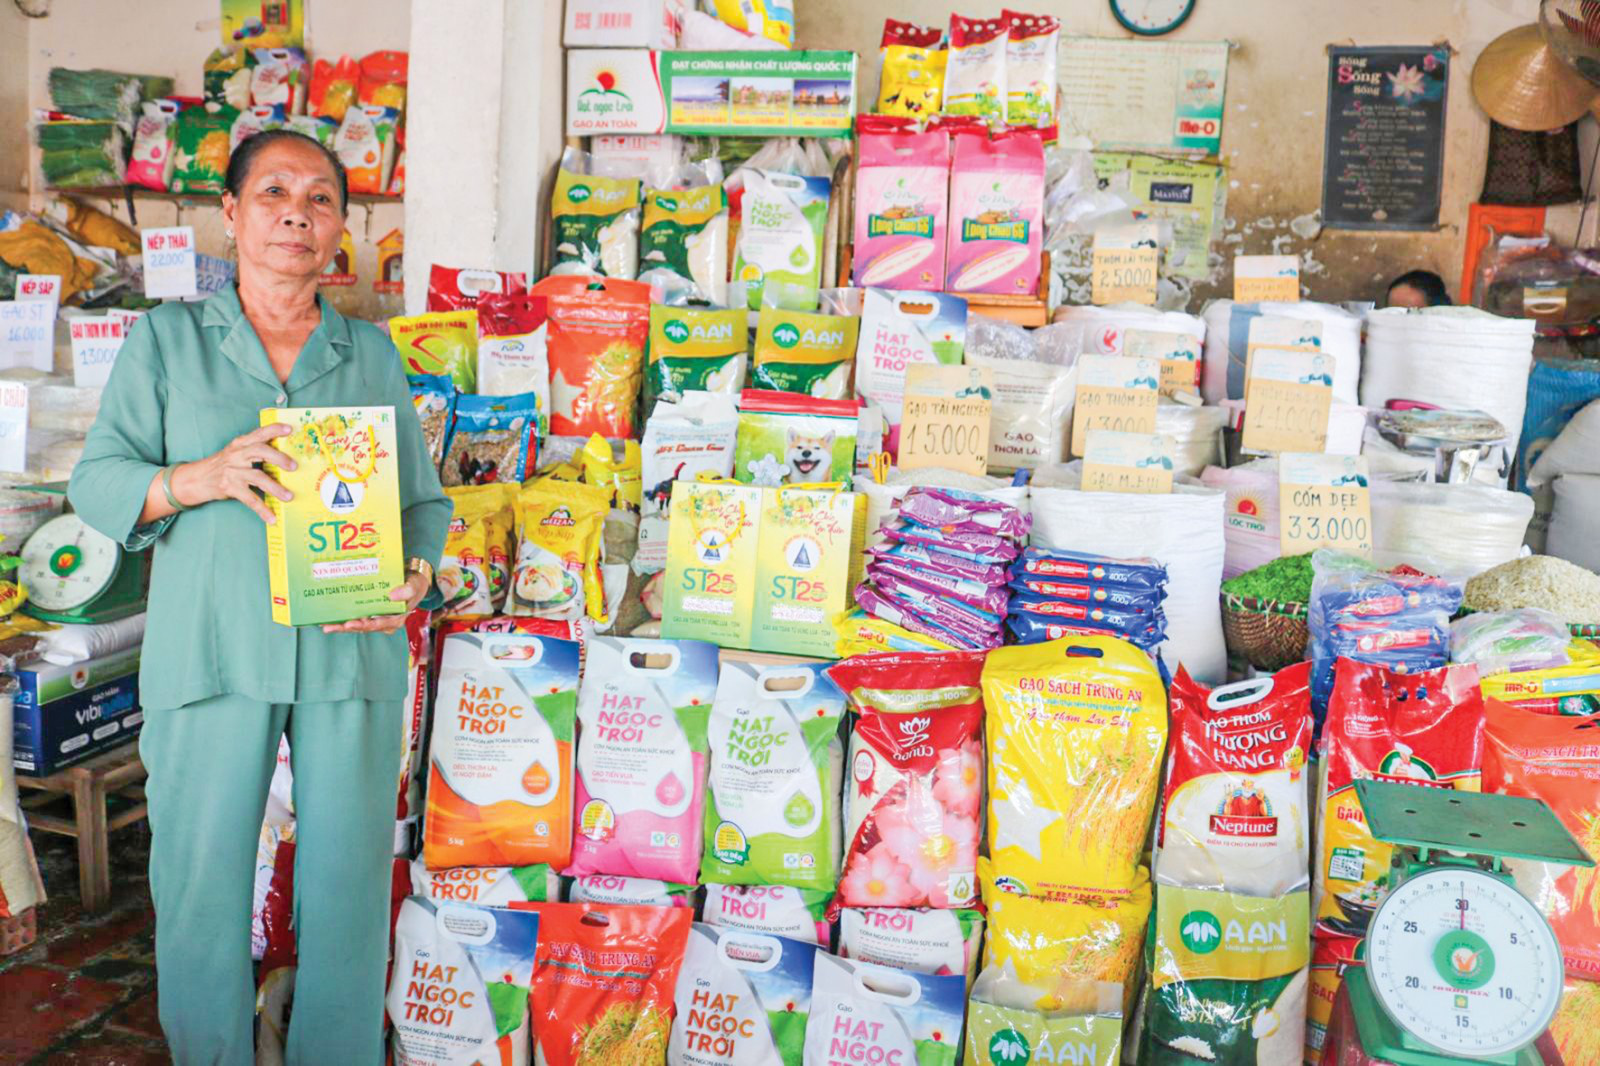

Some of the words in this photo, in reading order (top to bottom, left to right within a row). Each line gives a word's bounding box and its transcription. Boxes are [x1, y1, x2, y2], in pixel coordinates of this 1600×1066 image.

[595, 120, 608, 128] AN
[611, 118, 637, 128] TOÀN
[692, 325, 733, 338] AAN
[802, 329, 844, 344] AAN
[873, 343, 924, 361] NGỌC
[907, 401, 928, 418] GẠO
[1294, 487, 1321, 507] CỐM
[308, 520, 378, 552] ST25
[682, 568, 737, 594] ST25
[771, 576, 828, 602] ST25
[461, 681, 504, 701] HẠT
[1019, 678, 1045, 692] GẠO
[1048, 680, 1081, 697] SẠCH
[1086, 683, 1124, 701] TRUNG
[1128, 689, 1143, 702] AN
[459, 697, 524, 719] NGỌC
[601, 693, 646, 711] HẠT
[457, 714, 505, 734] TRỜI
[598, 711, 663, 728] NGỌC
[733, 717, 775, 735] HẠT
[596, 725, 643, 743] TRỜI
[728, 732, 790, 750] NGỌC
[726, 743, 771, 767] TRỜI
[1213, 817, 1275, 835] Neptune
[430, 879, 479, 902] TRỜI
[720, 896, 767, 921] TRỜI
[1455, 898, 1470, 912] 30
[863, 909, 914, 933] TRỜI
[1403, 921, 1419, 934] 25
[1224, 920, 1288, 945] AAN
[1510, 933, 1518, 945] 5
[416, 949, 430, 959] Gạo
[600, 951, 638, 966] TRUNG
[641, 954, 657, 968] AN
[412, 960, 459, 986] HẠT
[696, 978, 711, 988] Gạo
[1405, 975, 1420, 989] 20
[407, 980, 475, 1009] NGỌC
[692, 989, 740, 1014] HẠT
[1499, 987, 1513, 1000] 10
[404, 1001, 454, 1028] TRỜI
[837, 1002, 853, 1013] Gạo
[687, 1009, 756, 1038] NGỌC
[832, 1015, 884, 1041] HẠT
[1455, 1015, 1470, 1029] 15
[685, 1031, 735, 1059] TRỜI
[829, 1037, 903, 1065] NGỌC
[1034, 1039, 1097, 1062] AAN
